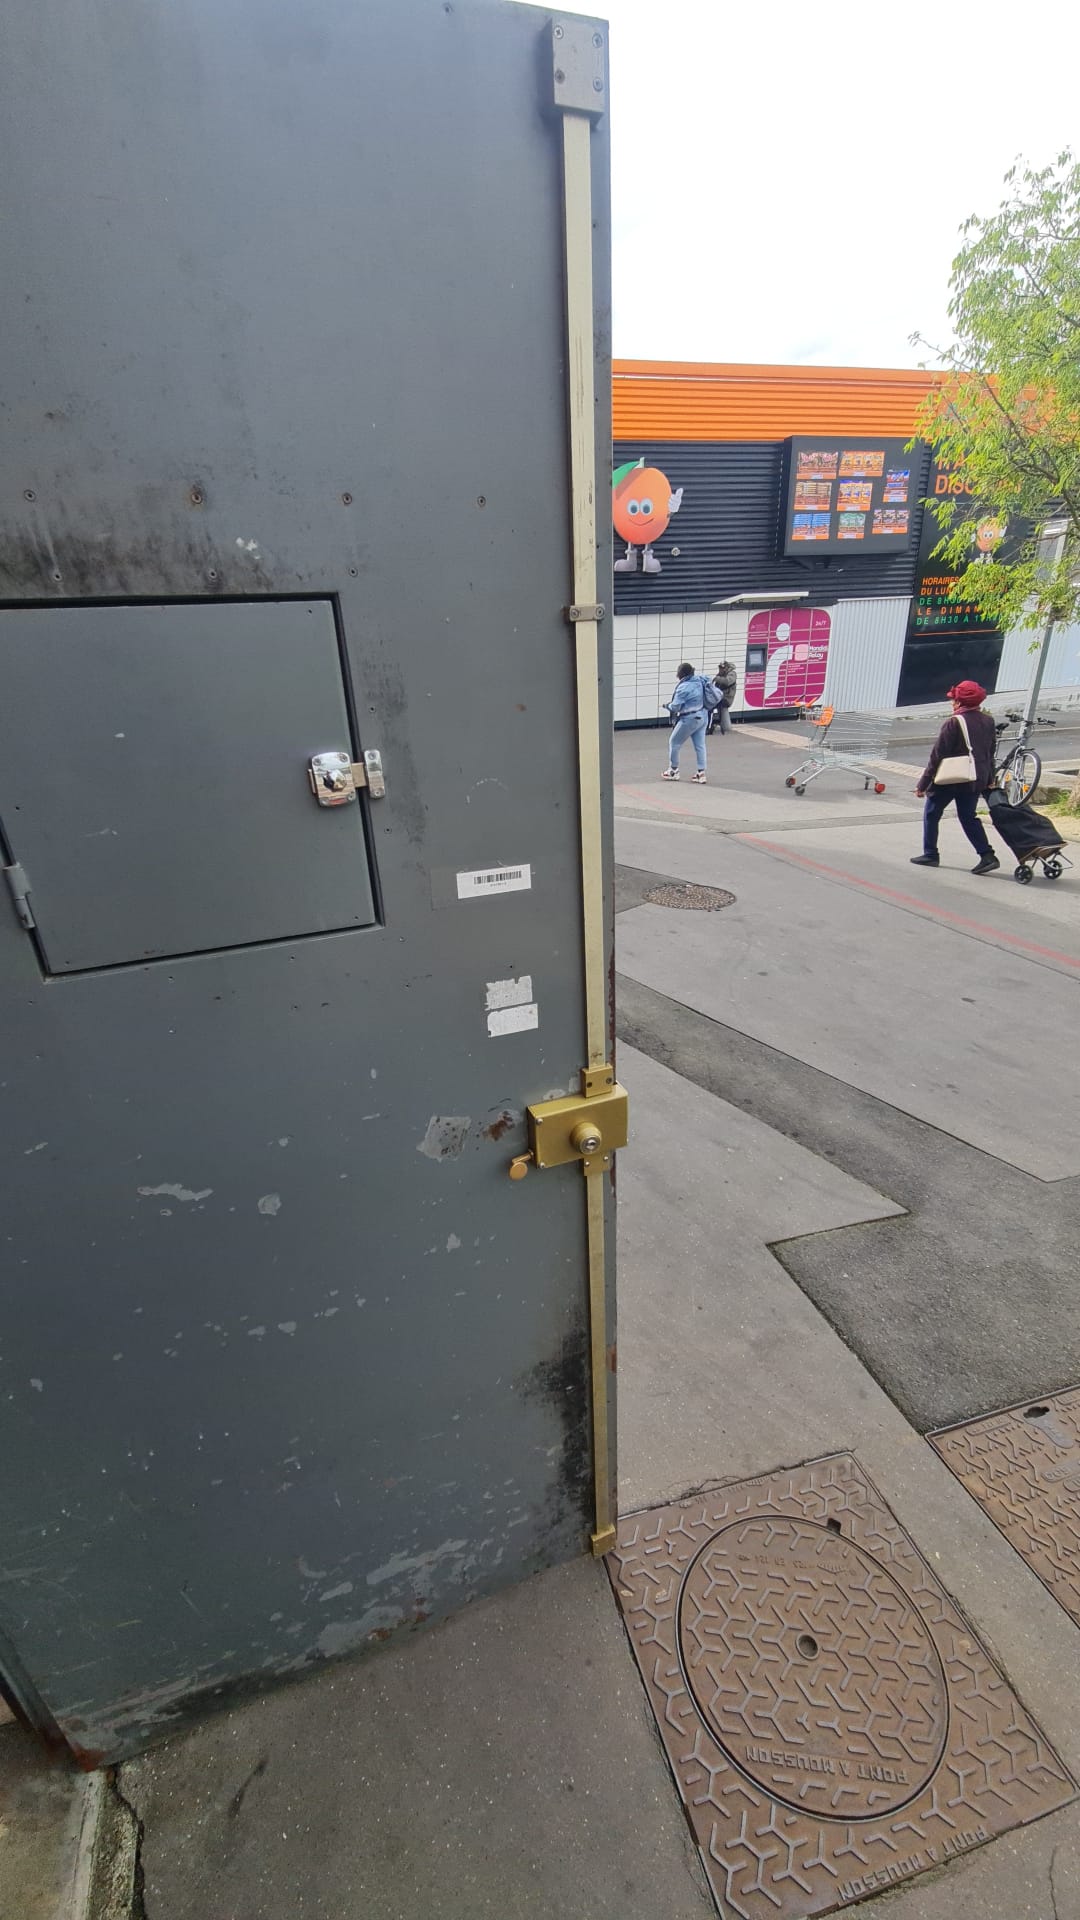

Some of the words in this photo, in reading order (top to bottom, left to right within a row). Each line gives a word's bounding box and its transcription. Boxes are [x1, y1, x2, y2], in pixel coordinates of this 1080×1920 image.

[920, 587, 932, 595] DU
[919, 597, 933, 605] DE
[917, 607, 932, 615] LE
[916, 617, 929, 625] DE
[934, 615, 959, 624] 8H30
[745, 1745, 835, 1775] MOUSSON
[837, 1853, 926, 1901] MOUSSON
